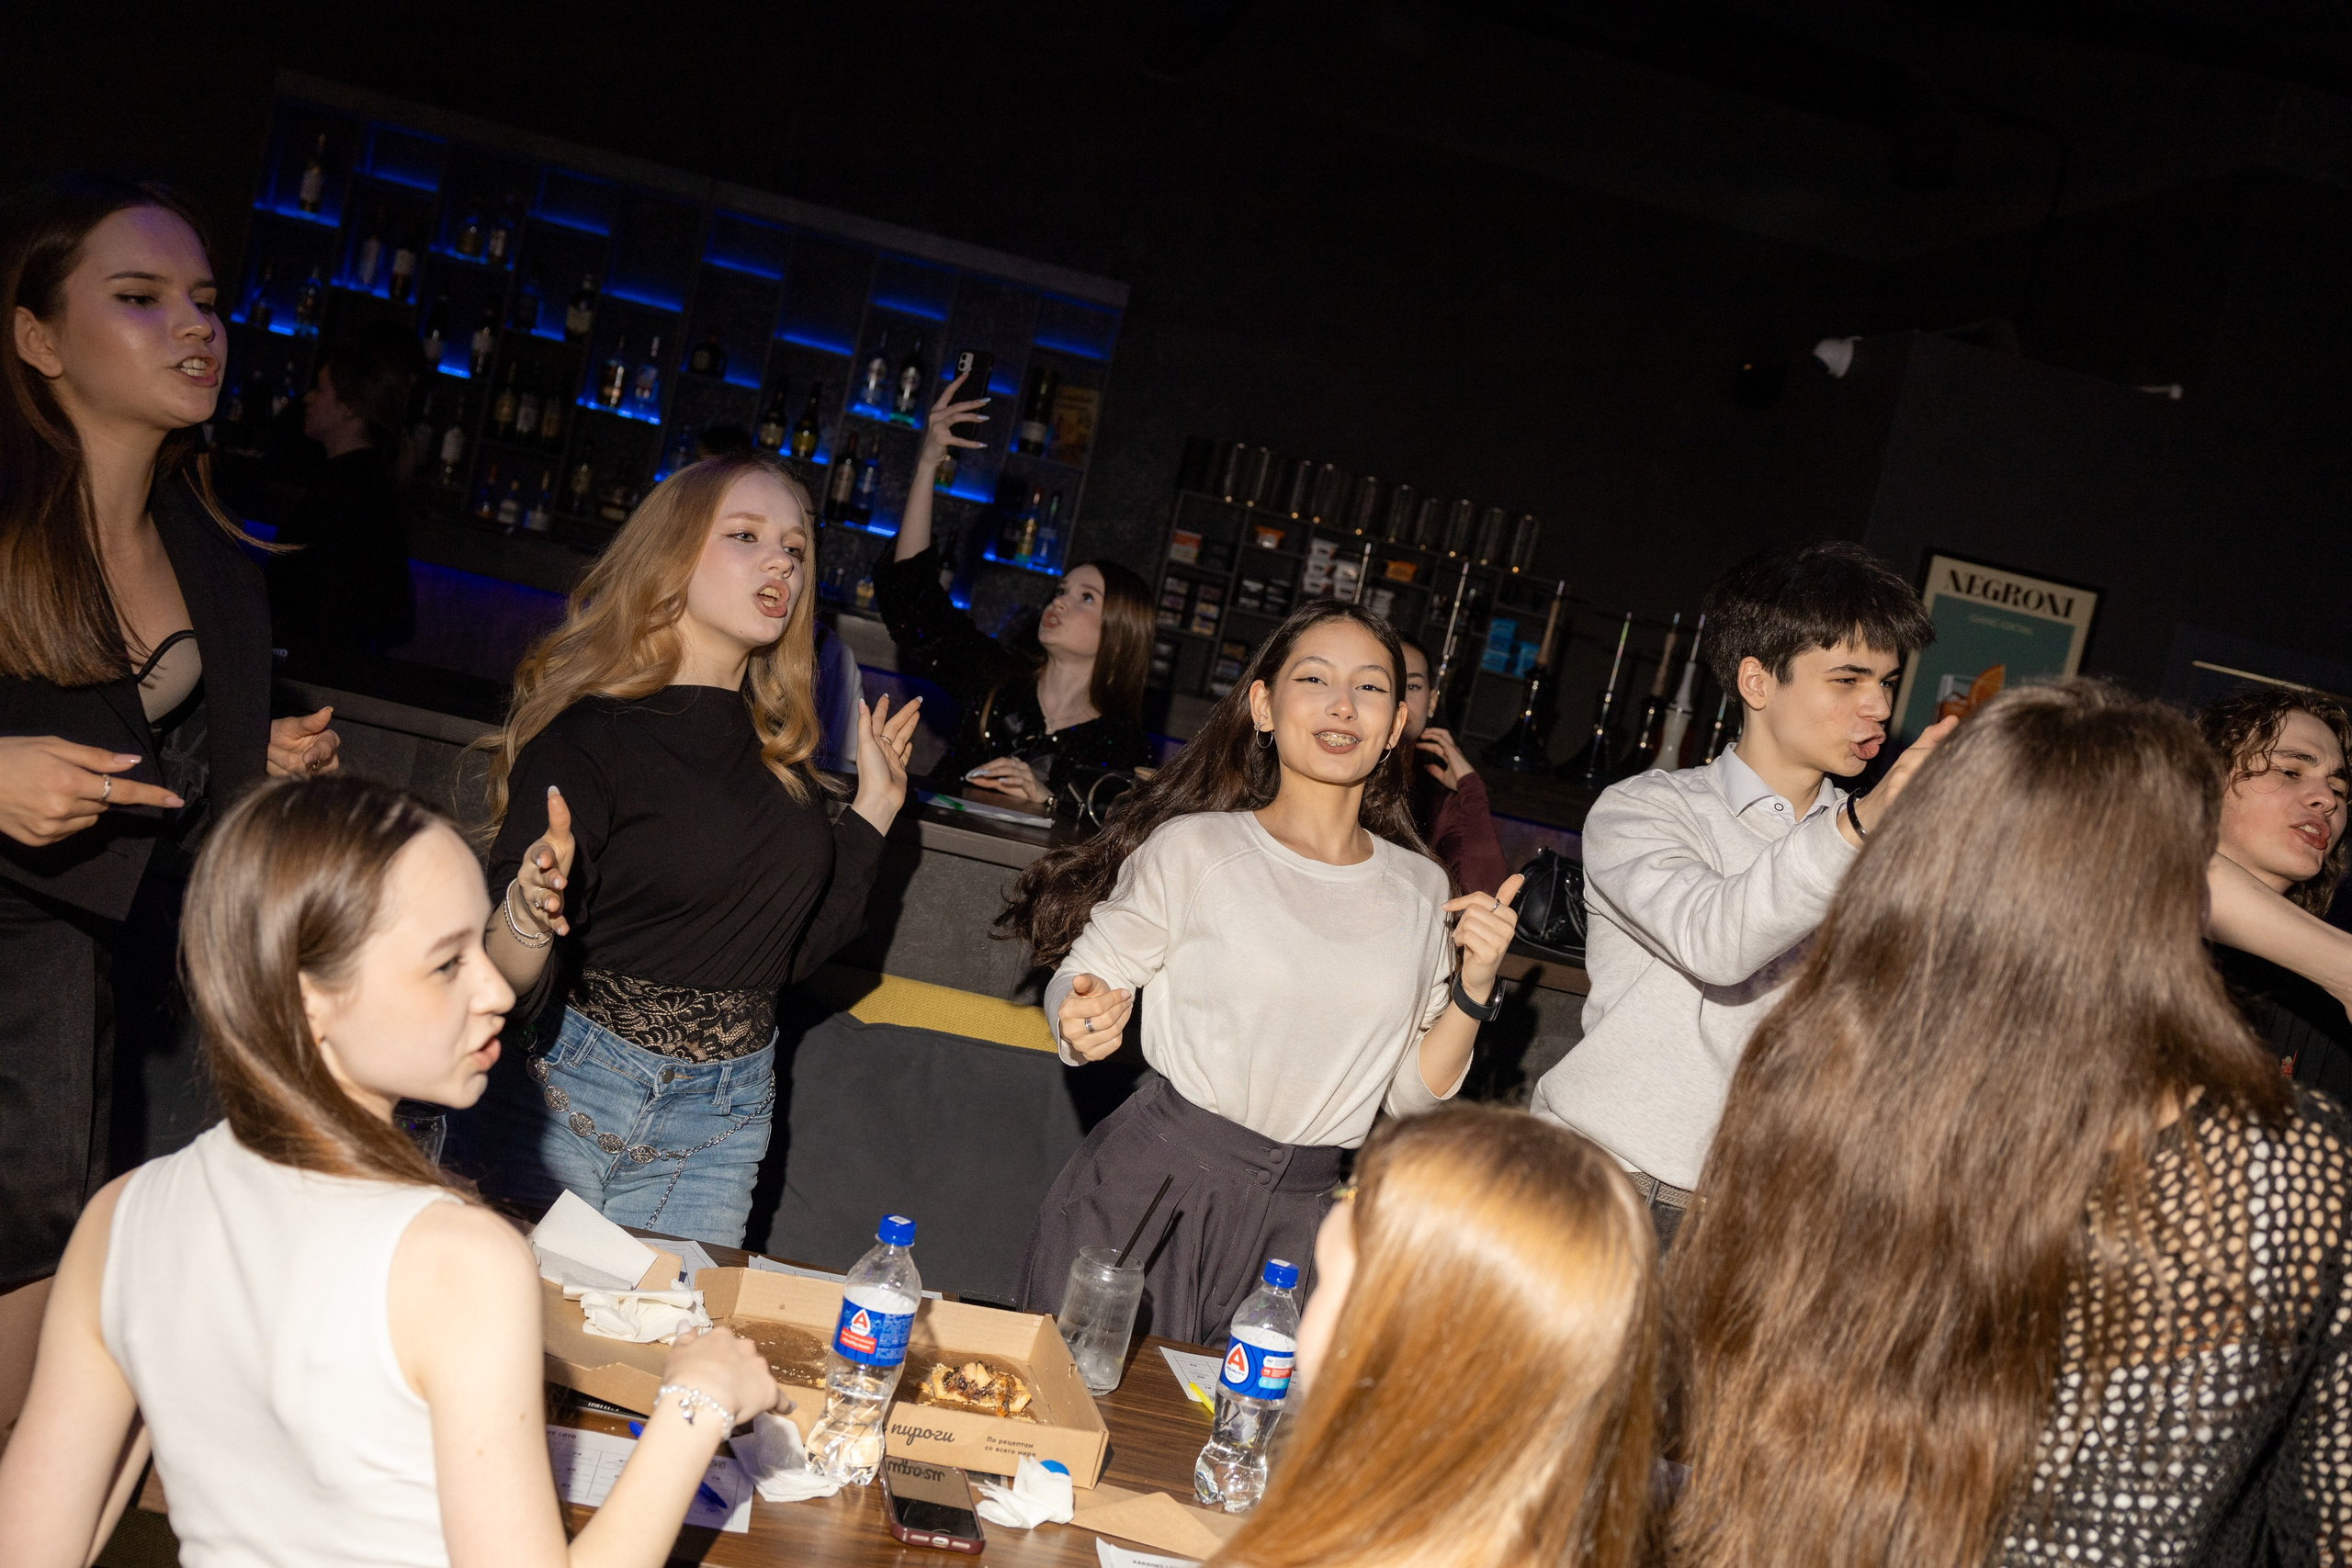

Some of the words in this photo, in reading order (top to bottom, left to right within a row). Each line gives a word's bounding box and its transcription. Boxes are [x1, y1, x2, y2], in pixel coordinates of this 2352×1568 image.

[1944, 570, 2075, 618] NEGRONI
[890, 1424, 956, 1446] пироги
[987, 1436, 997, 1444] По
[998, 1439, 1034, 1450] рецептам
